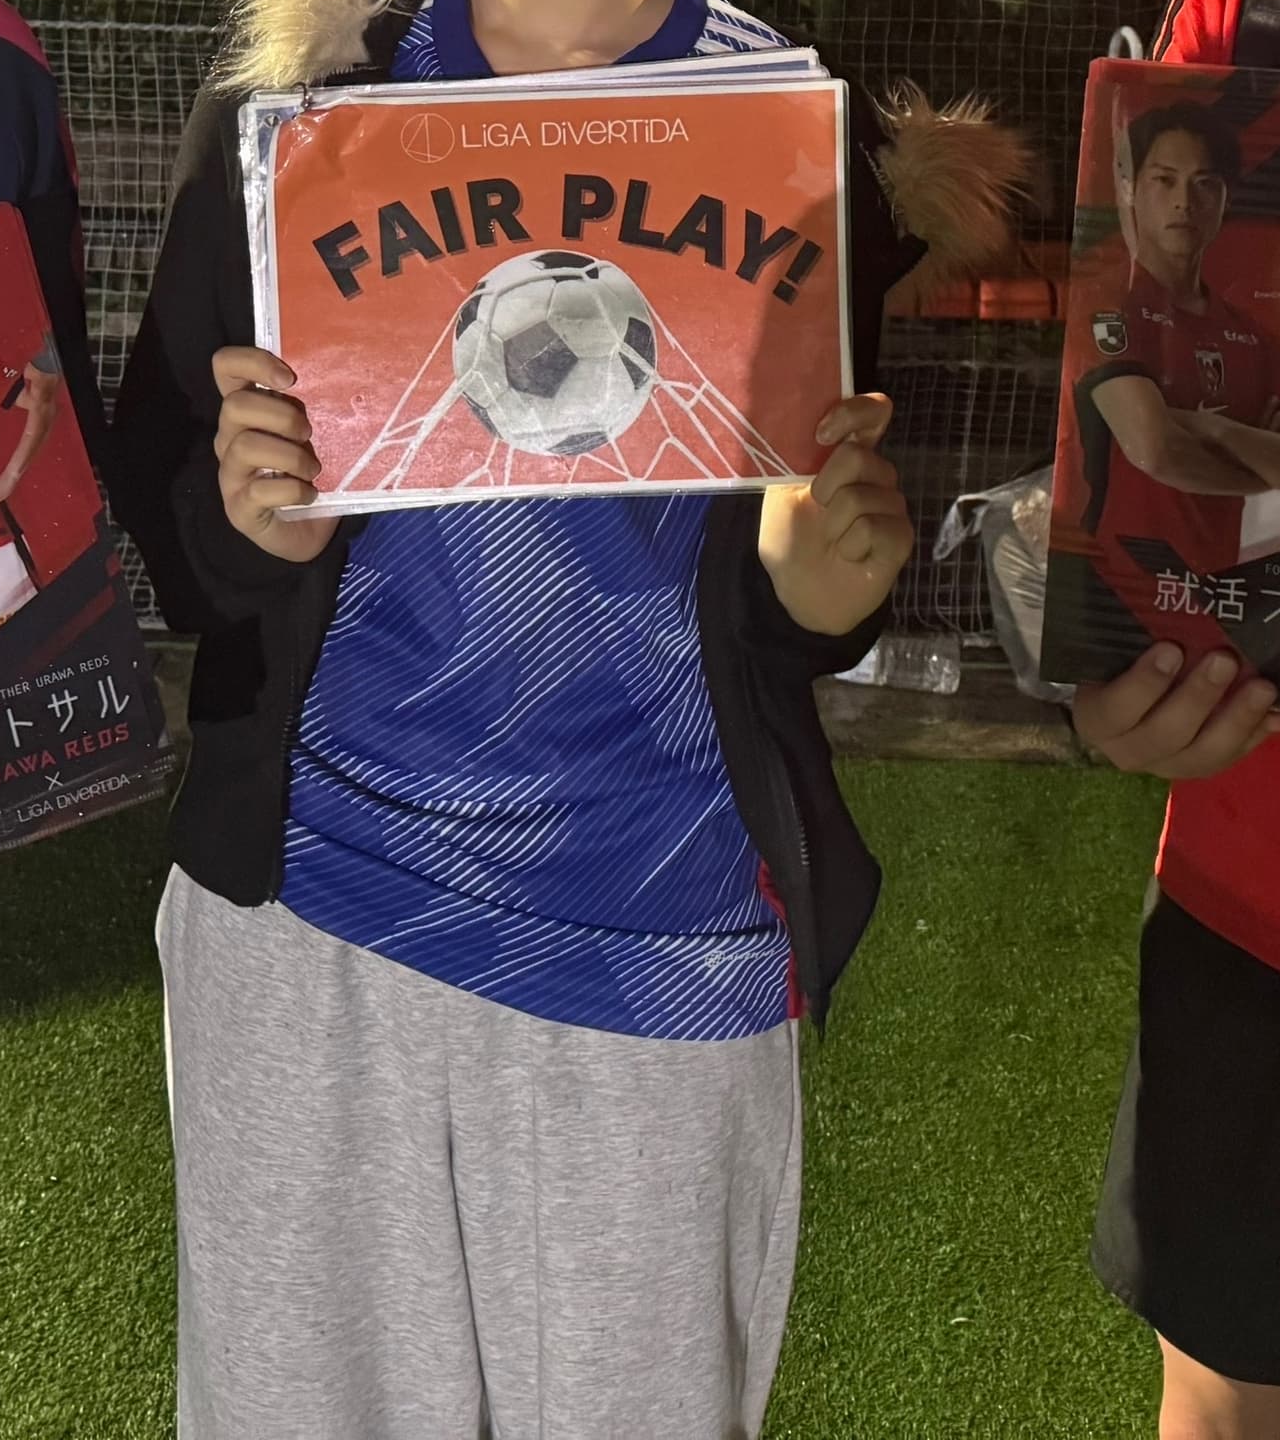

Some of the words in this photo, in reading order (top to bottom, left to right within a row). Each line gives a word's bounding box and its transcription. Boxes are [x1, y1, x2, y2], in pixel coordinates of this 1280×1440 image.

[312, 178, 532, 301] FAIR
[561, 173, 824, 305] PLAY!
[36, 667, 75, 688] URAWA
[80, 655, 110, 673] REDS
[64, 722, 130, 759] REDS
